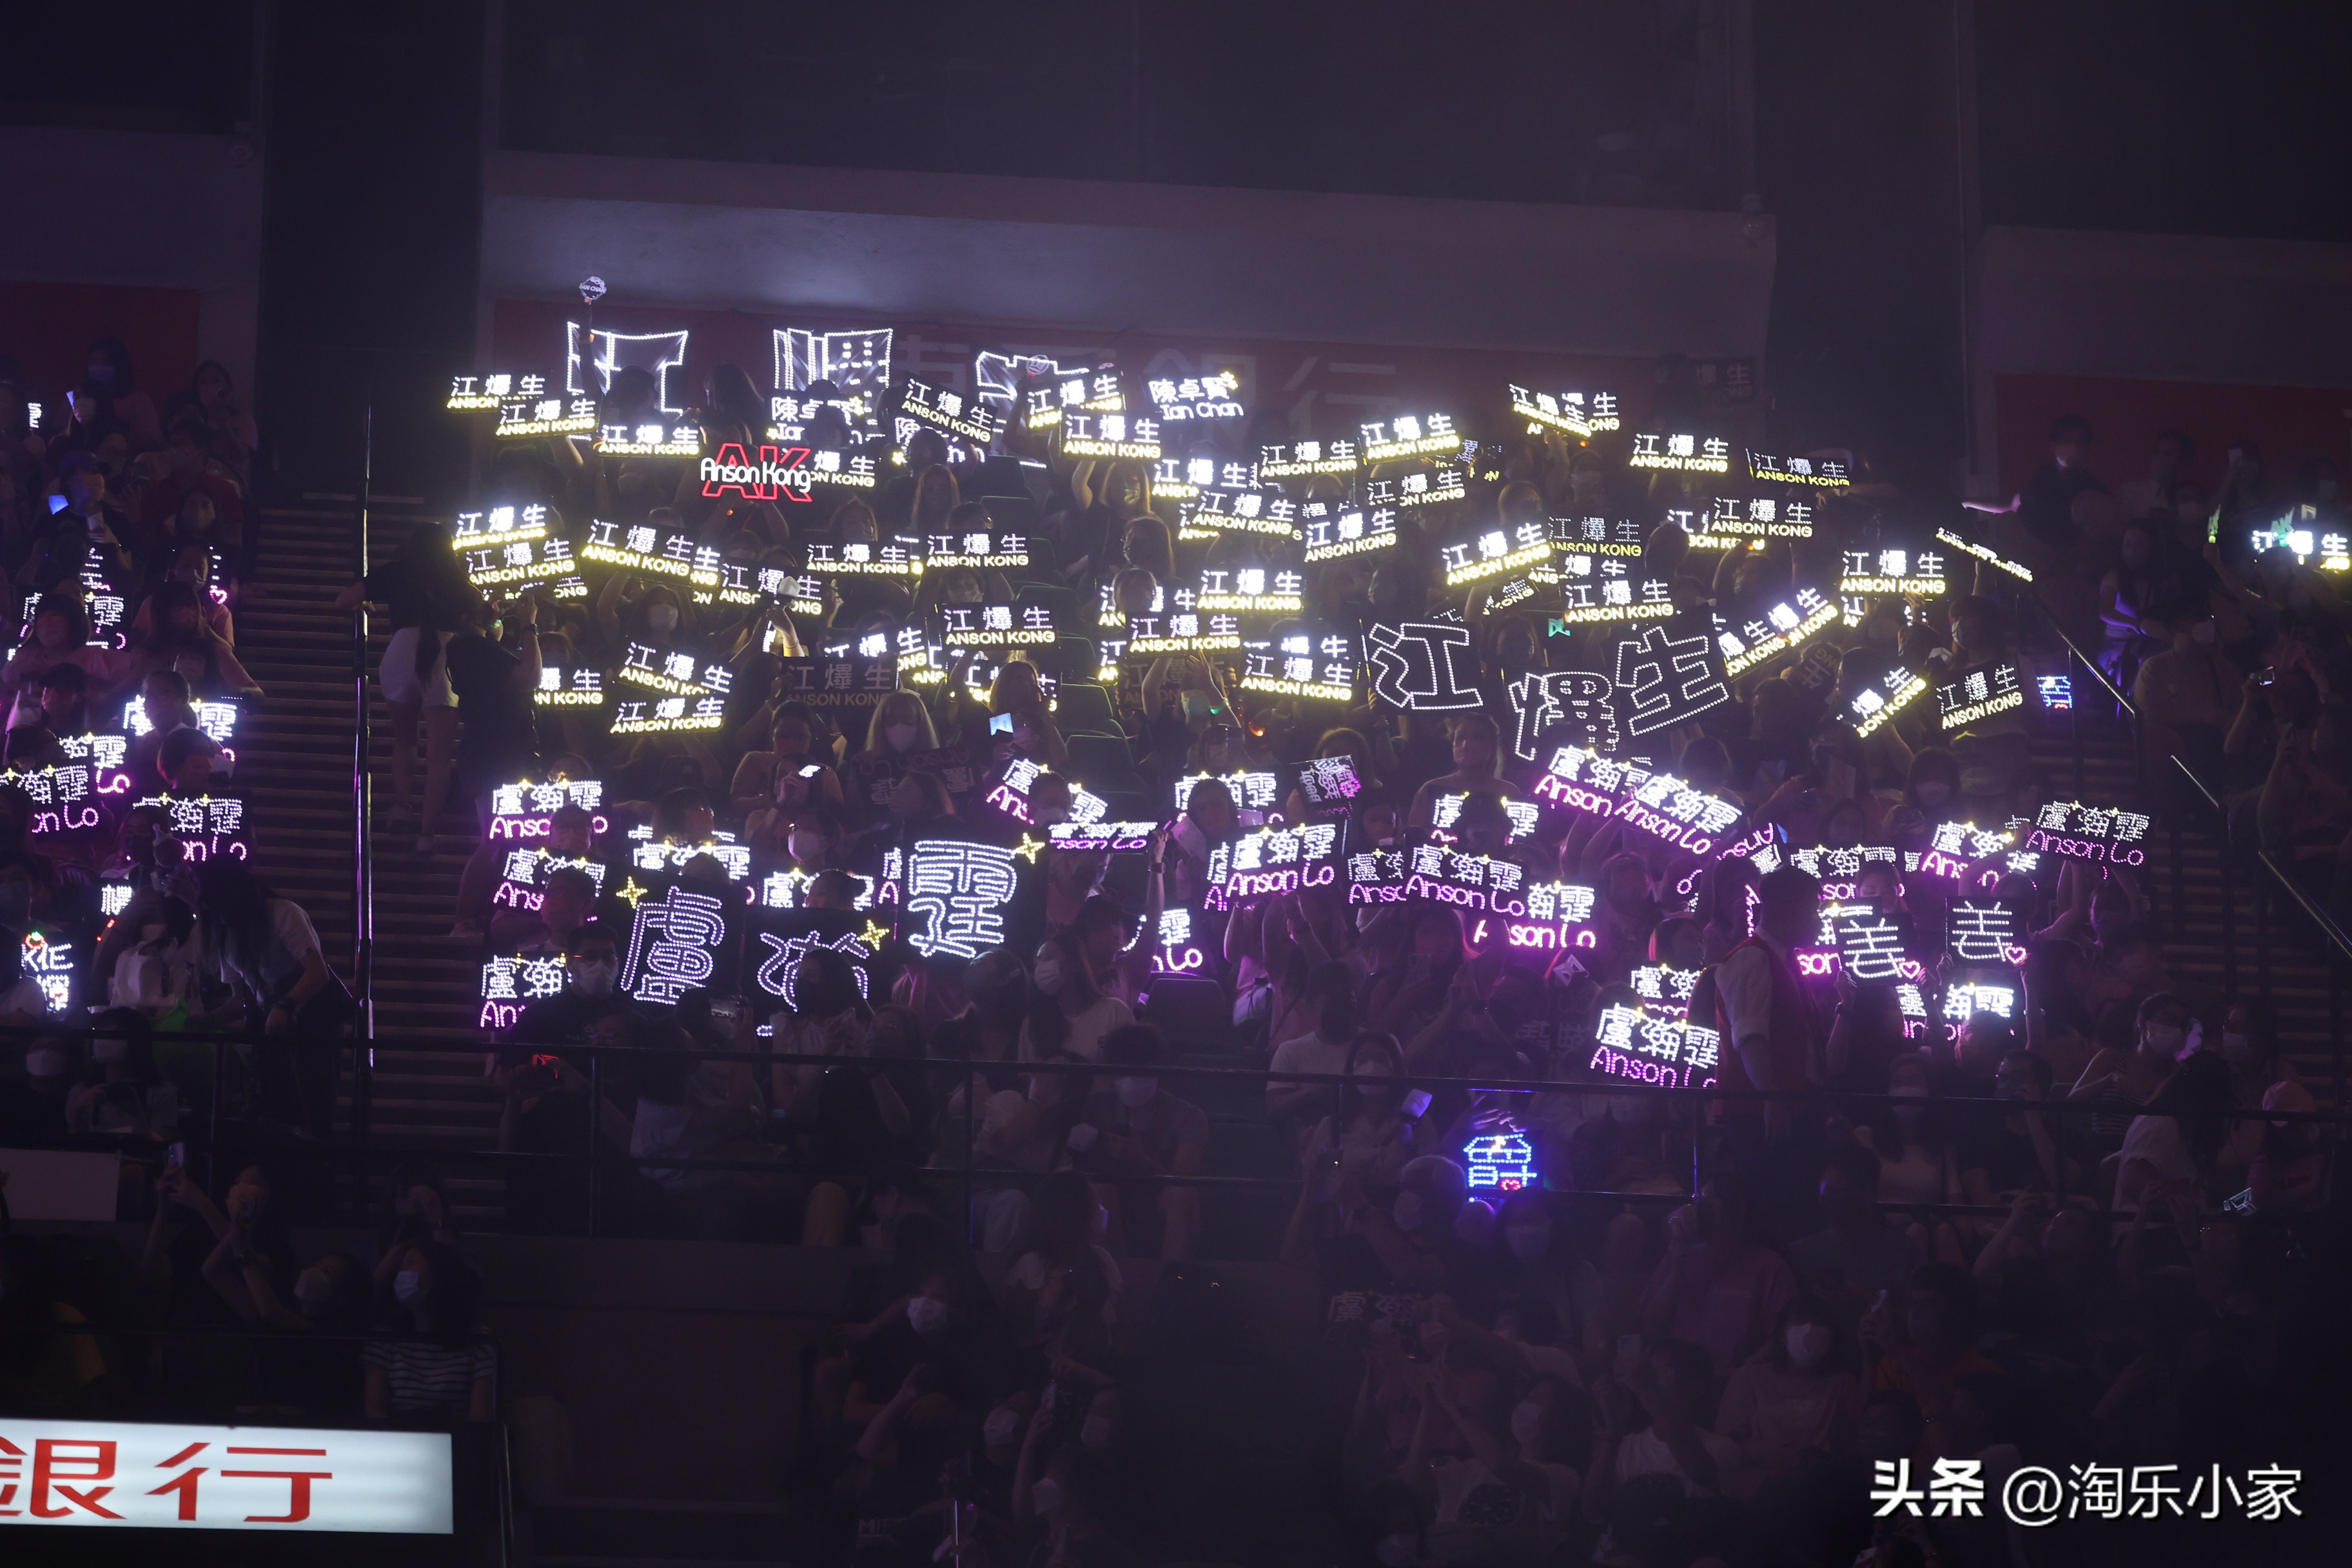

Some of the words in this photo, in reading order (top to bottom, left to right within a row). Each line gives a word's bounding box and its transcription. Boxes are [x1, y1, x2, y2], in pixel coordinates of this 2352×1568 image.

[447, 396, 500, 409] ANSON
[1148, 377, 1231, 404] 陳卓賢
[901, 400, 950, 427] ANSON
[950, 418, 992, 444] KONG
[1195, 401, 1245, 418] Chan
[495, 422, 551, 436] ANSON
[551, 416, 596, 433] KONG
[1555, 416, 1592, 439] KONG
[598, 443, 652, 455] ANSON
[653, 443, 700, 456] KONG
[1063, 440, 1117, 456] ANSON
[1117, 444, 1162, 459] KONG
[1367, 442, 1418, 460] ANSON
[1418, 435, 1460, 455] KONG
[700, 442, 813, 503] AK
[700, 457, 760, 484] Anson
[762, 460, 812, 493] Kong
[1260, 462, 1313, 478] ANSON
[1313, 460, 1358, 475] KONG
[1629, 455, 1685, 470] ANSON
[1685, 458, 1729, 473] KONG
[832, 473, 876, 487] KONG
[1755, 469, 1807, 485] ANSON
[1807, 476, 1850, 487] KONG
[1421, 487, 1466, 505] KONG
[1191, 513, 1246, 531] ANSON
[1247, 516, 1293, 536] KONG
[1710, 520, 1767, 536] ANSON
[1767, 524, 1813, 538] KONG
[1304, 540, 1355, 563] ANSON
[1355, 532, 1397, 553] KONG
[1599, 542, 1642, 558] KONG
[469, 566, 525, 585] ANSON
[527, 559, 576, 578] KONG
[581, 545, 641, 569] ANSON
[640, 554, 691, 578] KONG
[806, 561, 861, 574] ANSON
[862, 562, 909, 575] KONG
[925, 554, 981, 569] ANSON
[983, 554, 1030, 568] KONG
[1447, 558, 1504, 587] ANSON
[1504, 544, 1552, 570] KONG
[1839, 578, 1897, 593] ANSON
[1897, 578, 1946, 594] KONG
[1196, 595, 1253, 611] ANSON
[1254, 594, 1303, 611] KONG
[1567, 608, 1625, 623] ANSON
[1626, 603, 1674, 619] KONG
[1792, 604, 1839, 636] KONG
[945, 631, 1005, 647] ANSON
[1006, 630, 1057, 645] KONG
[1129, 638, 1190, 653] ANSON
[1191, 635, 1242, 652] KONG
[1750, 636, 1786, 667] KONG
[1369, 622, 1484, 710] 江
[618, 667, 679, 694] ANSON
[1240, 676, 1302, 696] ANSON
[1302, 683, 1353, 701] KONG
[1614, 625, 1730, 737] 生
[554, 692, 604, 705] KONG
[1883, 677, 1928, 717] KONG
[1940, 701, 1988, 732] ANSON
[1986, 690, 2024, 717] KONG
[609, 719, 671, 734] ANSON
[671, 716, 722, 732] KONG
[97, 769, 131, 794] Lo
[1534, 774, 1613, 818] Anson
[64, 804, 99, 829] Lo
[1613, 797, 1684, 842] Anson
[1679, 827, 1712, 855] Lo
[2025, 829, 2106, 861] Anson
[2110, 841, 2145, 867] Lo
[1226, 872, 1299, 899] Anson
[1301, 860, 1335, 888] Lo
[907, 839, 1017, 959] 霆
[1404, 874, 1487, 910] Anson
[1489, 890, 1527, 918] Lo
[1166, 946, 1203, 972] Lo
[1589, 1045, 1678, 1090] Anson
